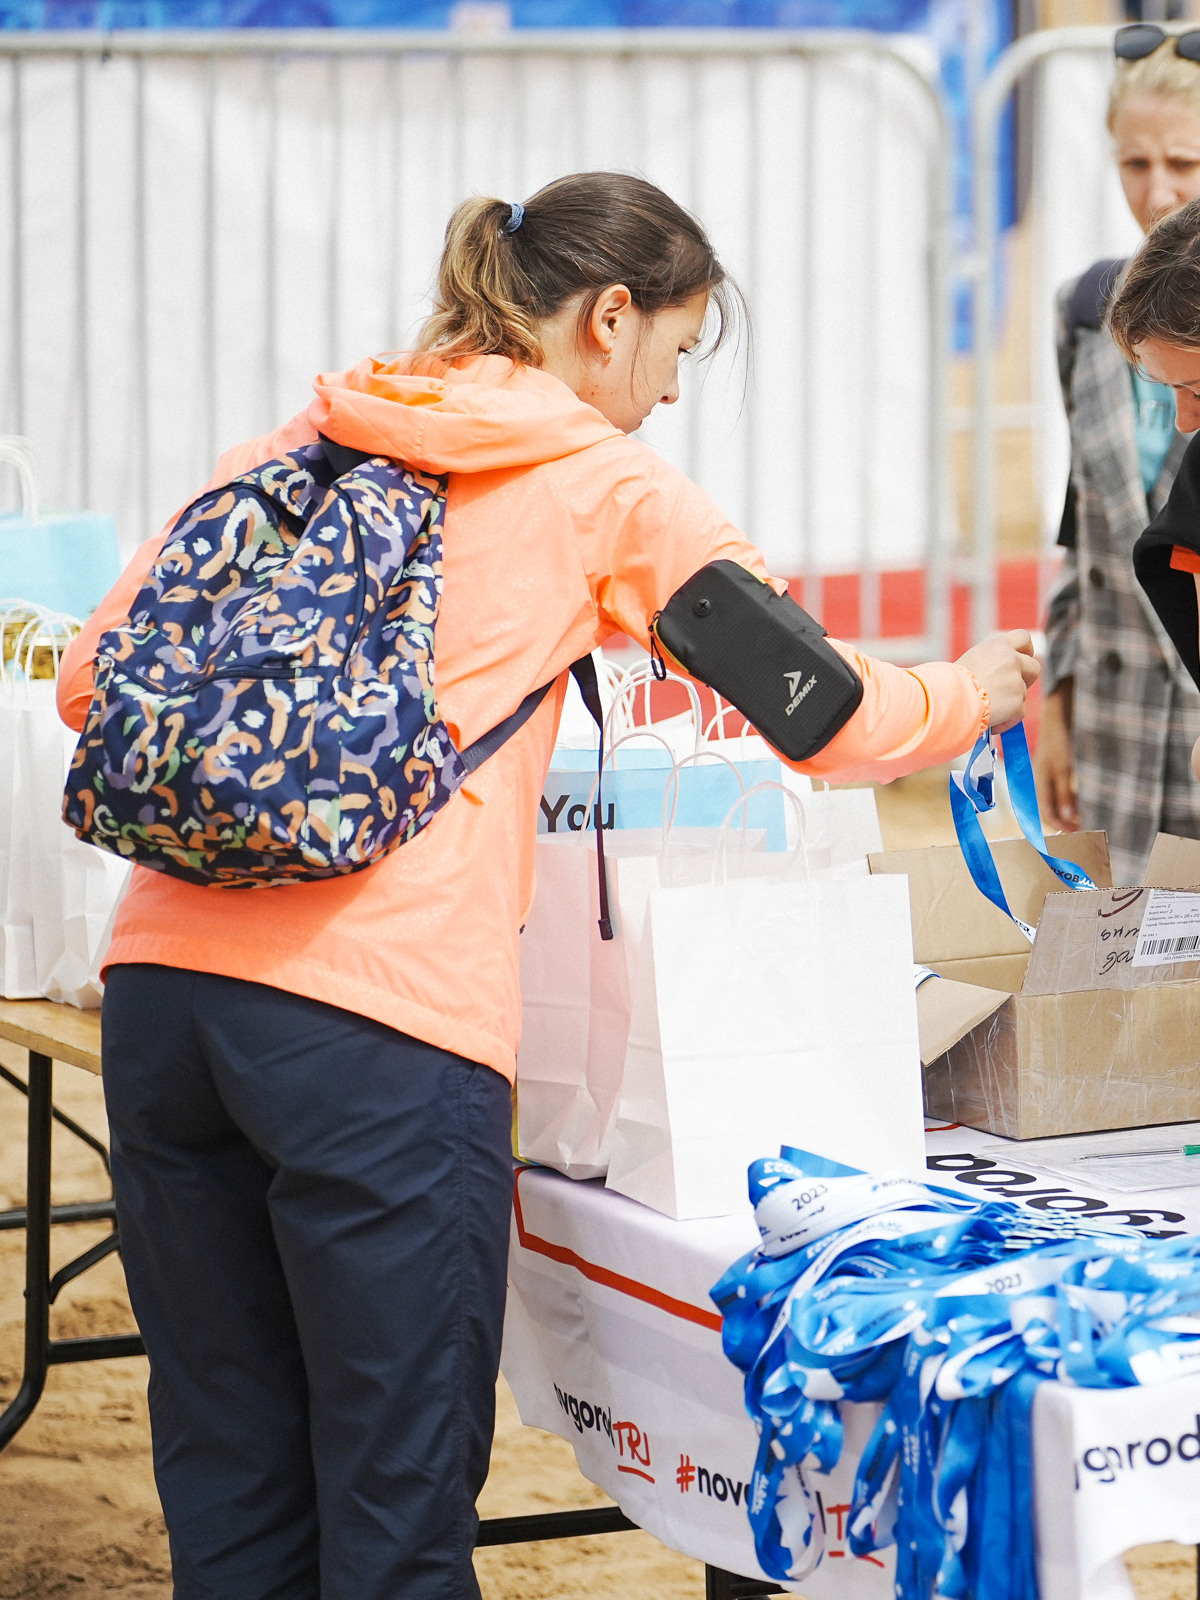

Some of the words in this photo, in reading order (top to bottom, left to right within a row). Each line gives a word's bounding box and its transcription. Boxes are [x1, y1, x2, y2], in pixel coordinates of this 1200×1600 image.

[785, 674, 818, 716] DEMIX
[539, 794, 615, 832] You
[791, 1184, 829, 1212] 2023
